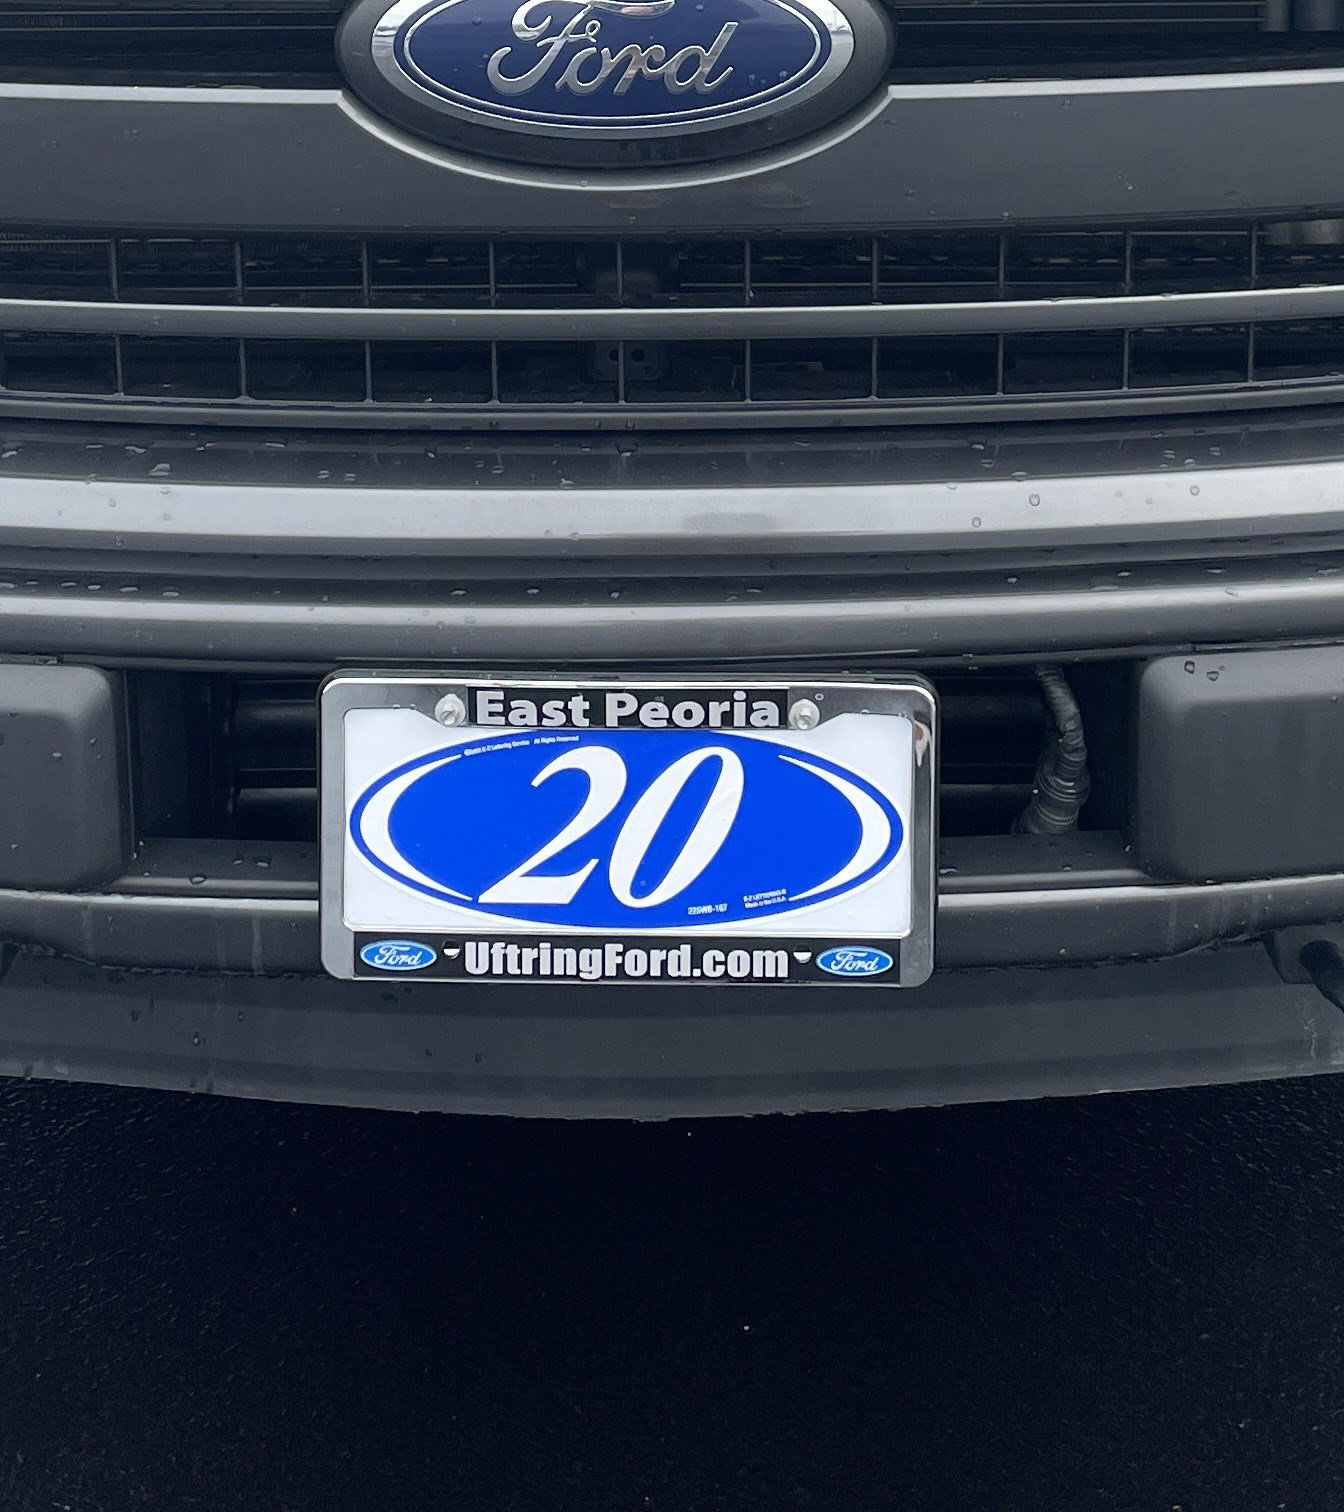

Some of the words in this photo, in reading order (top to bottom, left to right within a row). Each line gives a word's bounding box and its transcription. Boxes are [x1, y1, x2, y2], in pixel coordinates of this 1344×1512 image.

[476, 690, 590, 727] East
[606, 691, 780, 728] Peoria
[477, 745, 745, 909] 20
[374, 943, 423, 966] Ford
[464, 941, 789, 980] UftringFord.com
[830, 949, 879, 972] Ford
